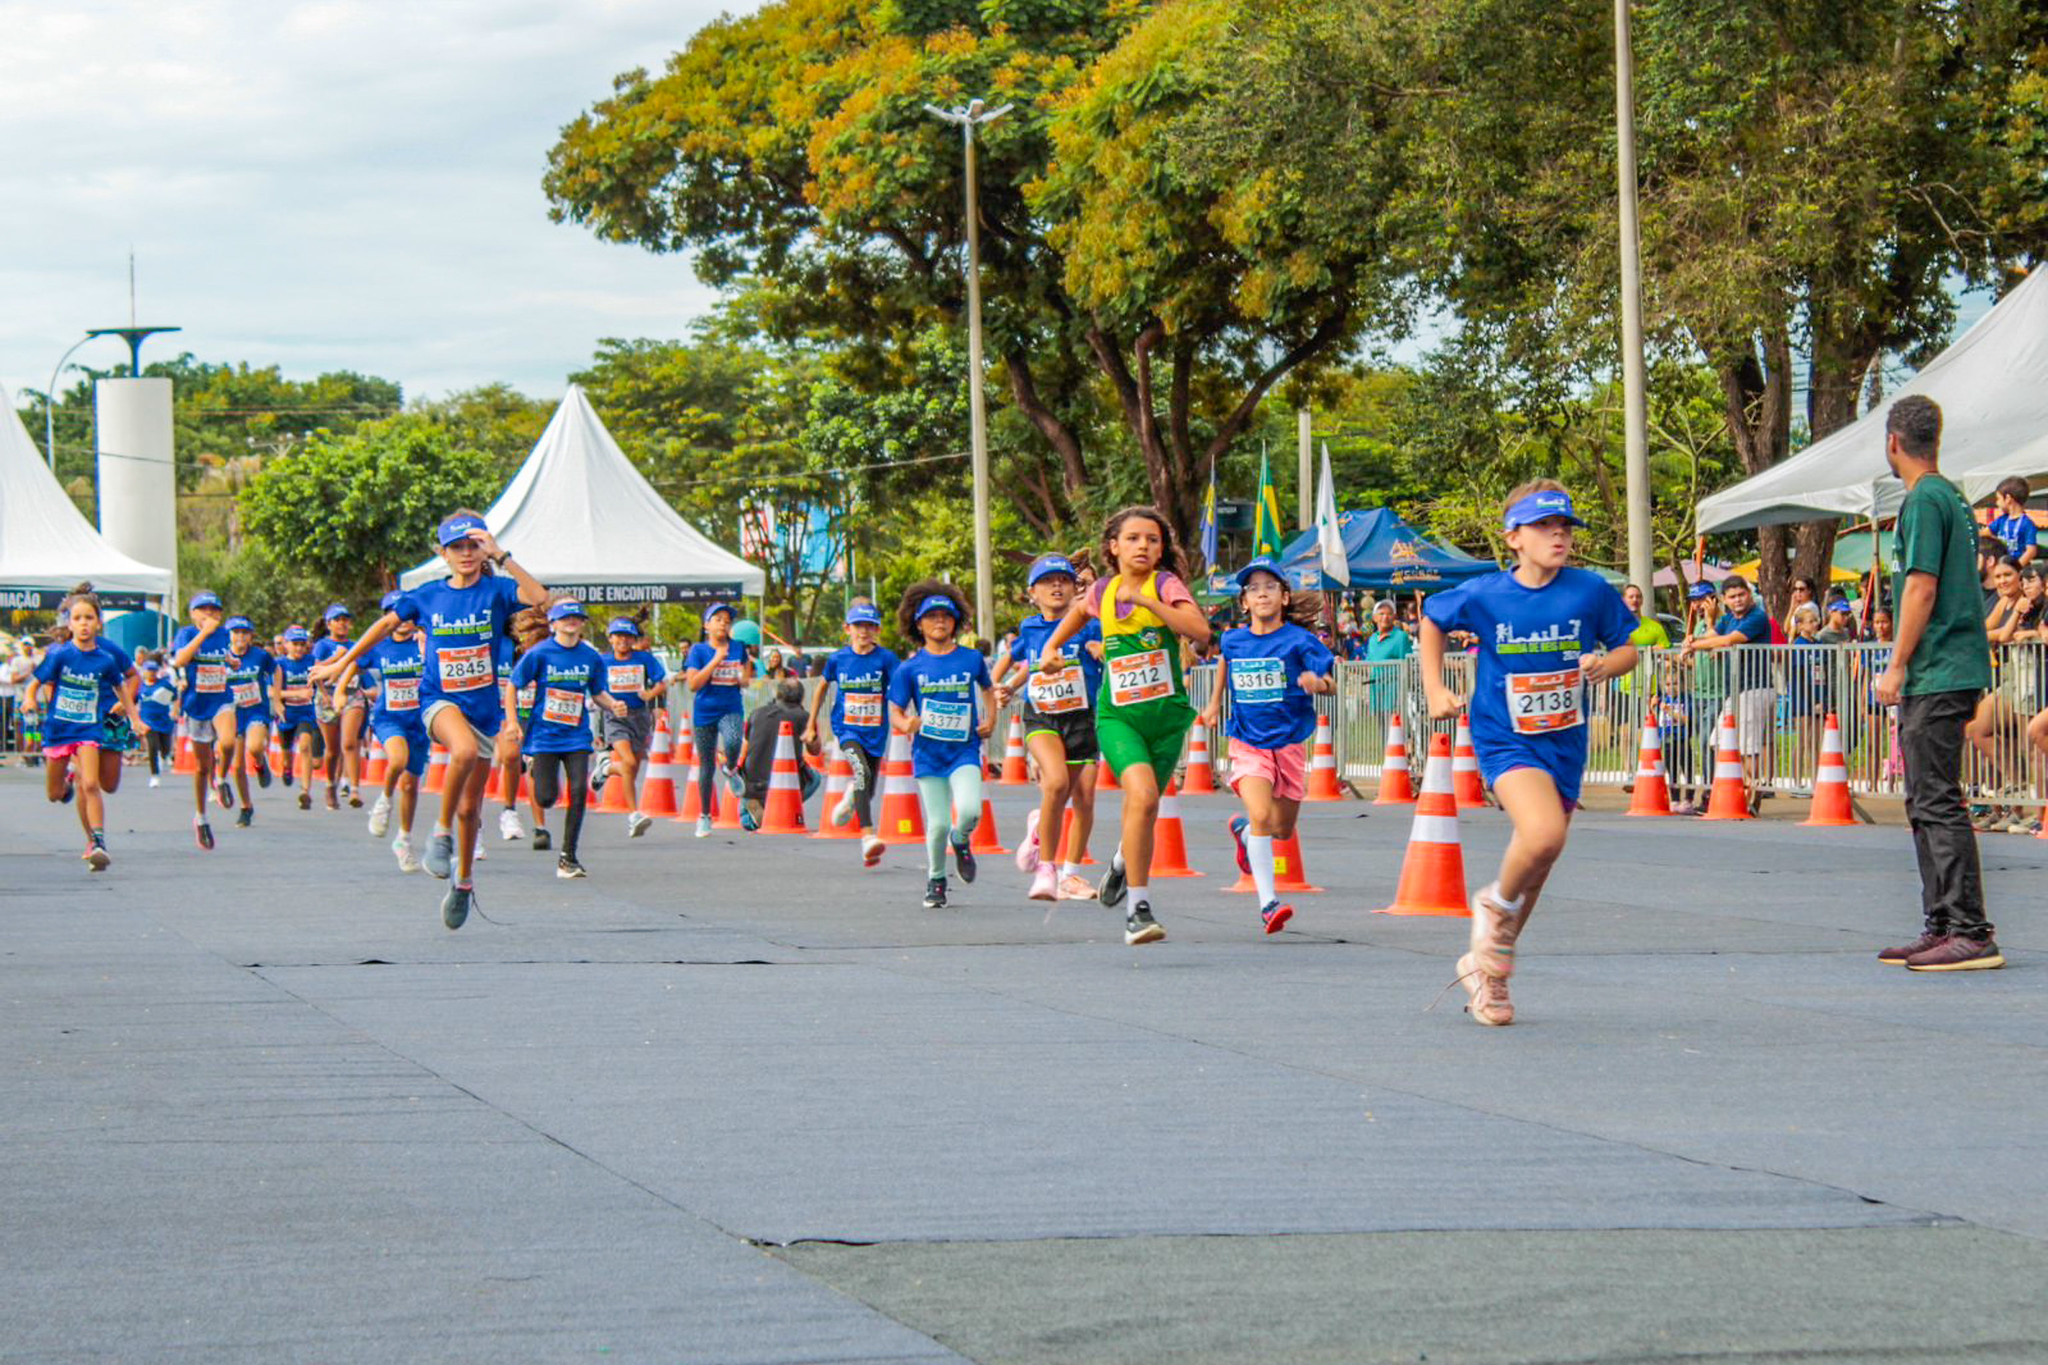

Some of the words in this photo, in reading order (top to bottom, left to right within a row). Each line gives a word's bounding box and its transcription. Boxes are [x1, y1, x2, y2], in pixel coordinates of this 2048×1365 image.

[589, 586, 603, 601] DE
[606, 586, 667, 601] ENCONTRO
[446, 660, 485, 677] 2845
[1119, 667, 1160, 688] 2212
[1239, 673, 1274, 687] 3316
[393, 689, 418, 699] 275
[1038, 683, 1075, 700] 2104
[549, 700, 577, 713] 2133
[1521, 690, 1573, 713] 2138
[849, 704, 876, 715] 2113
[928, 713, 962, 728] 3377
